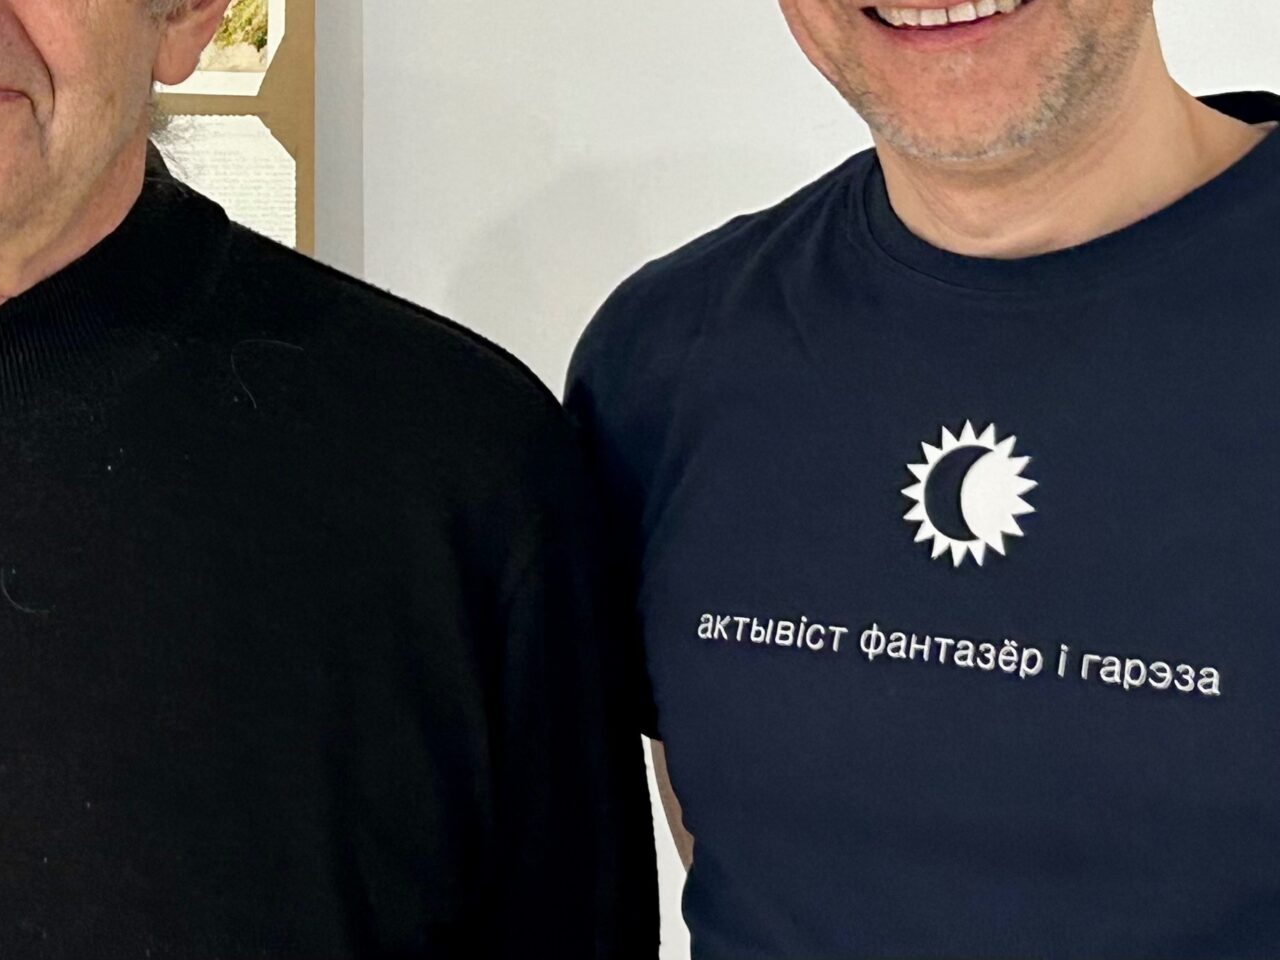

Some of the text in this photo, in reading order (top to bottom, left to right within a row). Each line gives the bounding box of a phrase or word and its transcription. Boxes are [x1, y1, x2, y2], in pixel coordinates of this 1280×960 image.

[697, 613, 1222, 696] актывіст фантазёр і гарэза
